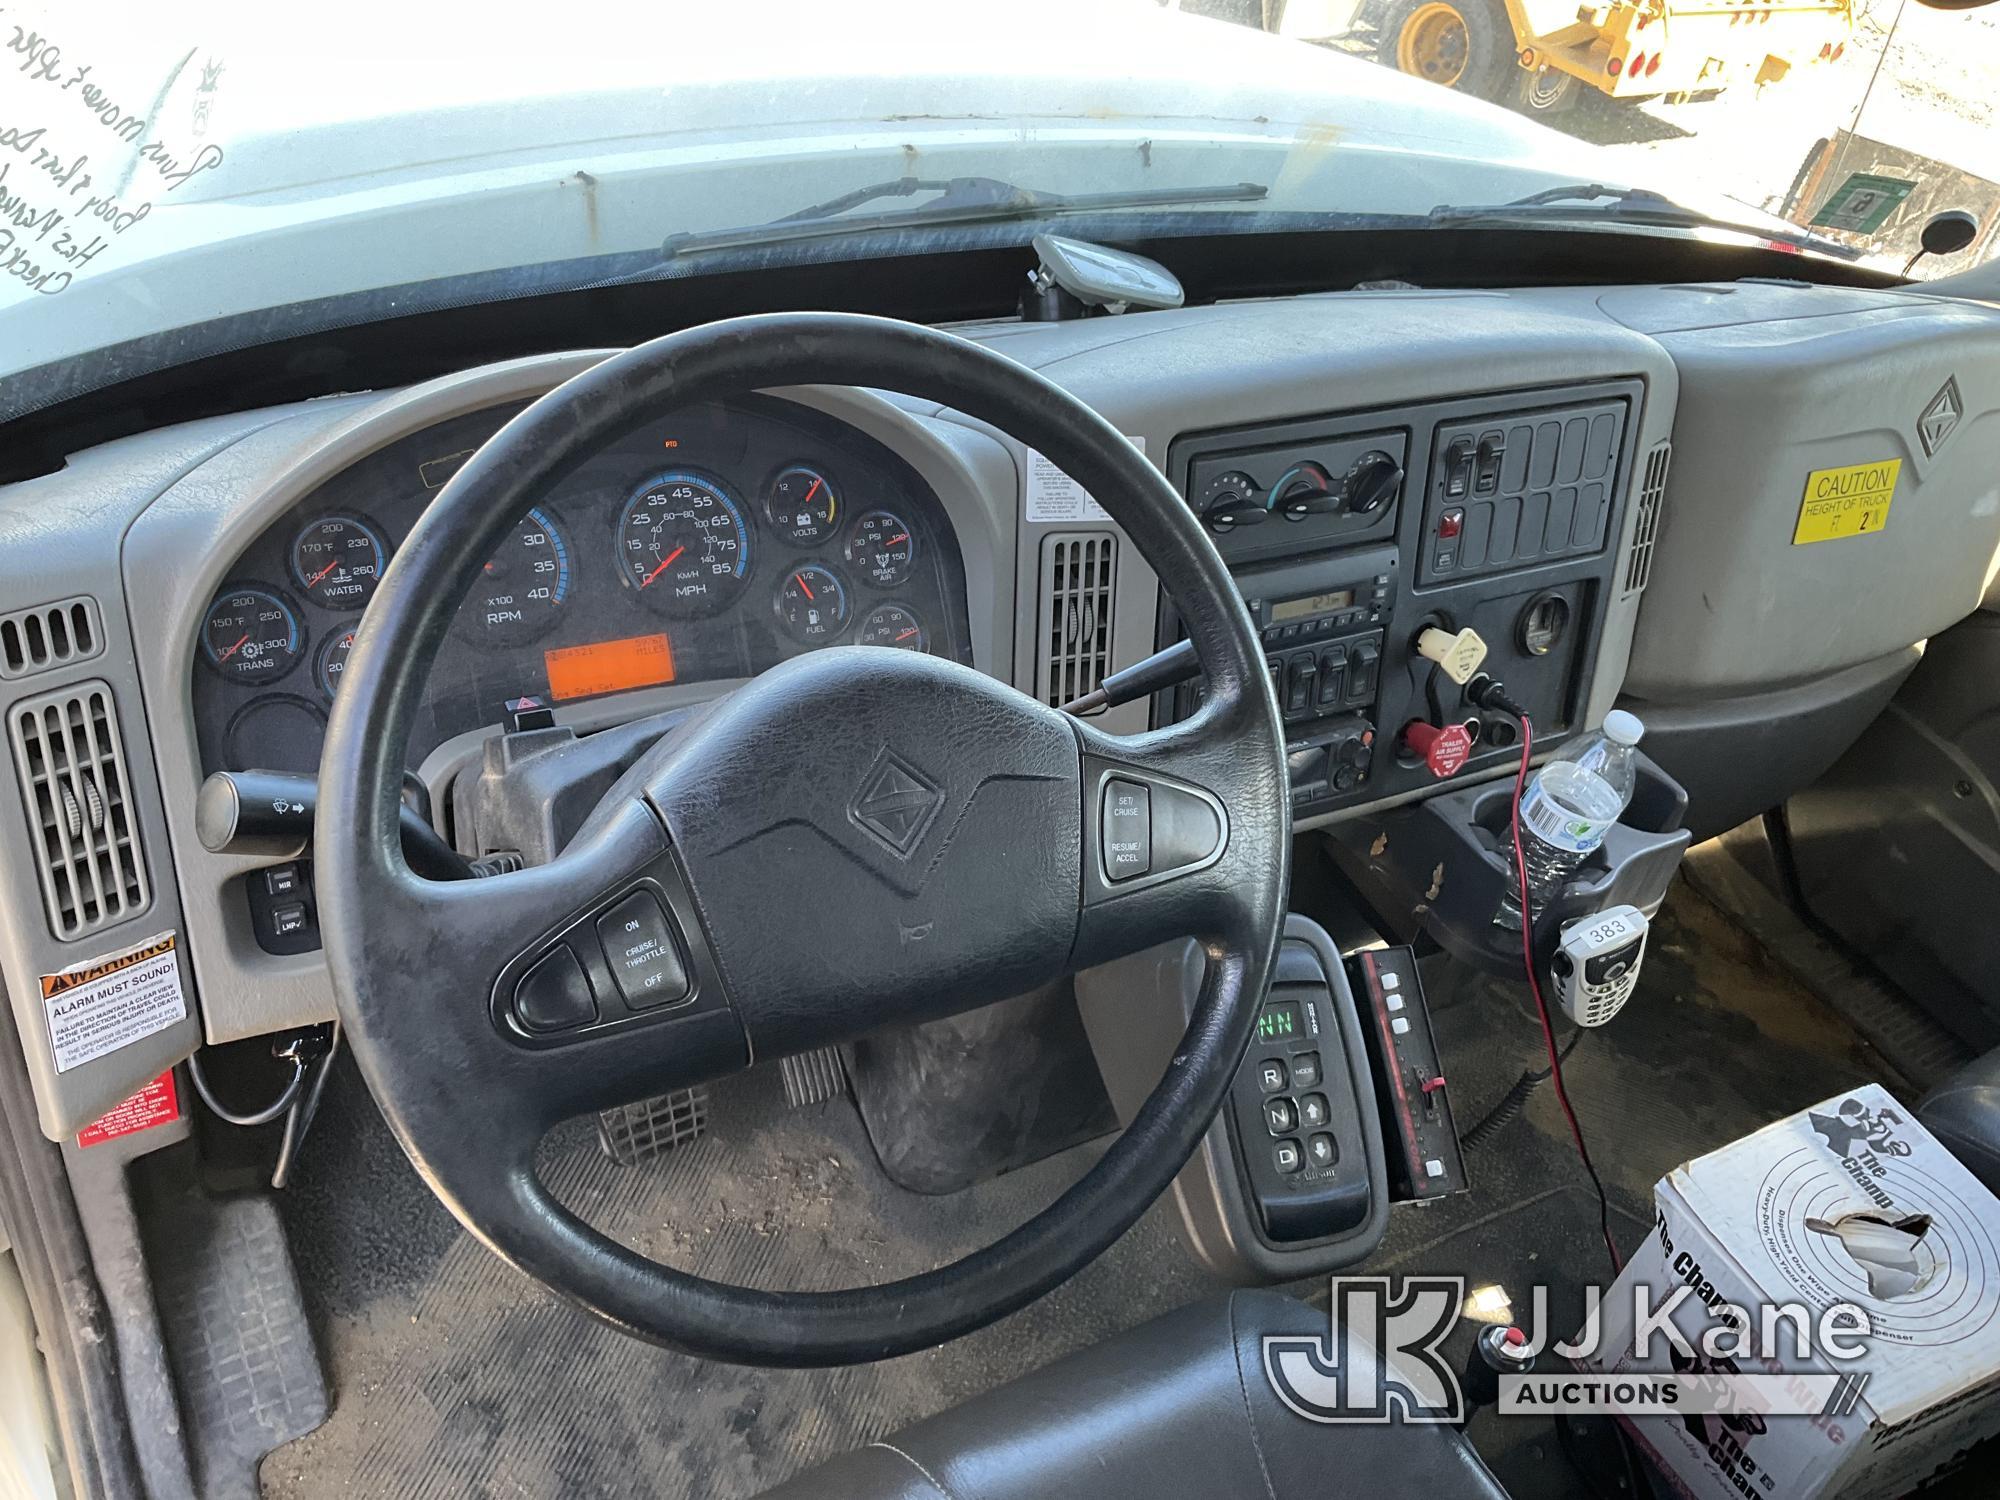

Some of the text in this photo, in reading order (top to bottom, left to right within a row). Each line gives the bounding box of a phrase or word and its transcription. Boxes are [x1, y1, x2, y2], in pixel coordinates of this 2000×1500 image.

[779, 483, 789, 491] 12
[1817, 467, 1891, 498] CAUTION
[672, 487, 692, 498] 45
[647, 494, 667, 506] 35
[693, 496, 713, 508] 55
[1805, 494, 1888, 516] HEIGHT OF TRUCK
[632, 513, 651, 525] 25
[683, 510, 695, 518] 80
[711, 514, 730, 526] 65
[694, 520, 709, 528] 100
[1859, 512, 1870, 530] 2
[322, 523, 344, 534] 200
[650, 525, 662, 534] 40
[792, 527, 818, 537] VOLTS
[347, 538, 369, 548] 230
[523, 534, 545, 546] 30
[703, 535, 718, 544] 120
[854, 539, 866, 547] 30
[868, 533, 881, 541] PSI
[302, 543, 322, 553] 170
[627, 539, 642, 551] 15
[648, 542, 660, 551] 20
[717, 540, 737, 552] 75
[891, 552, 906, 560] 150
[352, 565, 374, 575] 260
[534, 560, 555, 573] 35
[634, 563, 645, 573] 5
[712, 563, 731, 574] 85
[872, 567, 897, 577] BRAKE
[802, 572, 815, 580] 1/2
[324, 584, 363, 597] WATER
[527, 587, 550, 600] 40
[675, 584, 707, 598] MPH
[785, 590, 798, 598] 1/4
[822, 585, 835, 593] 3/4
[232, 597, 255, 607] 200
[259, 611, 282, 621] 250
[487, 610, 522, 624] RPM
[891, 613, 902, 621] 90
[212, 618, 233, 628] 150
[806, 625, 826, 634] FUEL
[878, 627, 891, 635] PSI
[864, 633, 875, 641] 30
[264, 638, 287, 649] 300
[236, 659, 274, 672] TRANS
[328, 663, 343, 672] 20
[1114, 807, 1139, 816] CRUISE
[1116, 853, 1139, 862] ACCEL
[624, 919, 640, 932] ON
[1589, 920, 1625, 944] 383
[625, 938, 658, 957] CRUISE/
[625, 946, 667, 969] THROTTLE
[644, 972, 663, 987] OFF
[53, 994, 95, 1019] ALARM
[97, 980, 129, 1000] MUST
[132, 962, 175, 986] SOUND!
[55, 1020, 85, 1036] FAILURE
[86, 1015, 96, 1024] TO
[96, 1002, 128, 1020] MAINTAIN
[135, 991, 156, 1004] CLEAR
[157, 983, 174, 996] VIEW
[56, 989, 176, 1043] IN THE DIRECTION OF TRAVEL COULD
[55, 1037, 82, 1051] RESULT
[91, 1020, 121, 1035] SERIOUS
[122, 1010, 145, 1023] INJURY
[146, 1004, 157, 1013] OR
[80, 1032, 114, 1051] OPERATOR
[122, 1012, 163, 1033] RESPONSIBLE
[78, 1046, 95, 1058] SAFE
[95, 1033, 131, 1053] OPERATION
[131, 1027, 140, 1036] OF
[1264, 1069, 1278, 1085] R
[1295, 1067, 1314, 1075] MODE
[1271, 1109, 1286, 1124] N
[1279, 1149, 1294, 1164] D
[1857, 1147, 1888, 1180] The
[1841, 1156, 1895, 1210] Champ
[1656, 1208, 1675, 1260] The
[1778, 1209, 1831, 1296] Dispenses One Wipe
[1768, 1237, 1800, 1284] High-Yield
[1673, 1250, 1748, 1336] Champ
[1718, 1425, 1757, 1475] The
